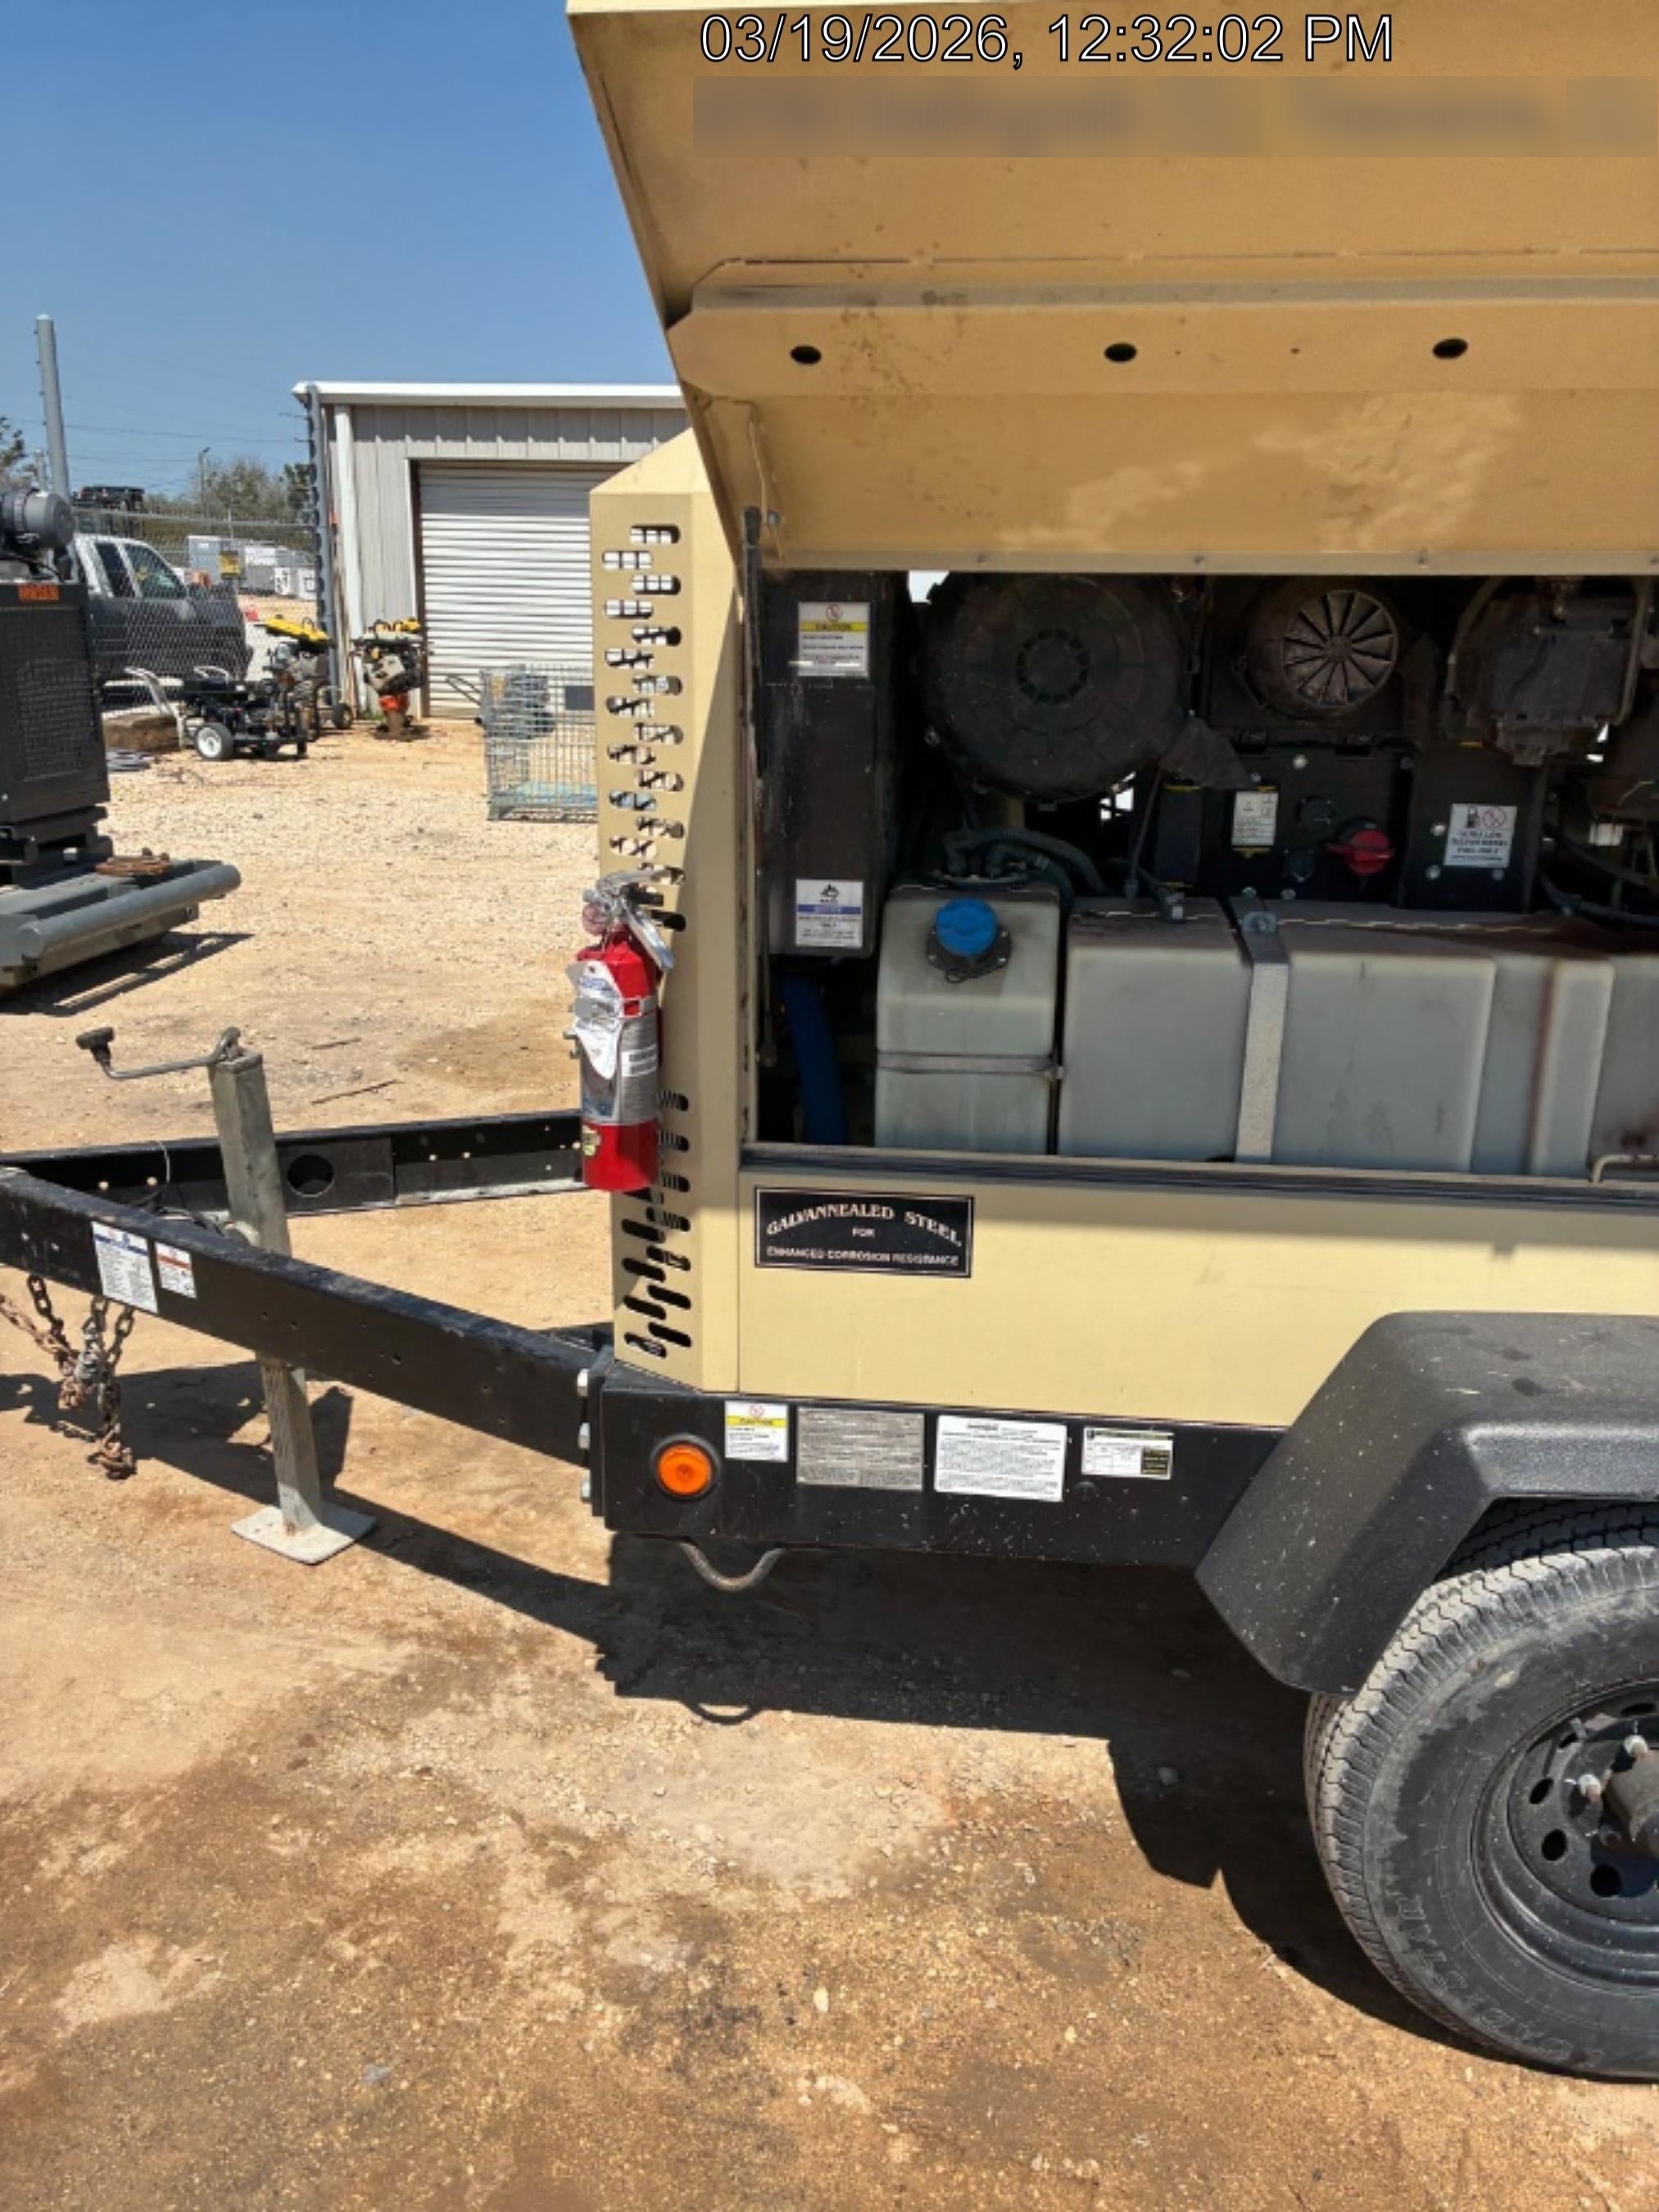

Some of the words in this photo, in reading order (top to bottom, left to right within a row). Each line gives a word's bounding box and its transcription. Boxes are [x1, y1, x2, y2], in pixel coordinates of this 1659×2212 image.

[766, 1203, 895, 1235] GALVANNEALED
[904, 1211, 962, 1247] STEEL
[852, 1227, 875, 1237] FOR
[767, 1246, 824, 1259] ENHANCED
[827, 1250, 891, 1262] CORROSION
[891, 1253, 959, 1267] RESISTANCE
